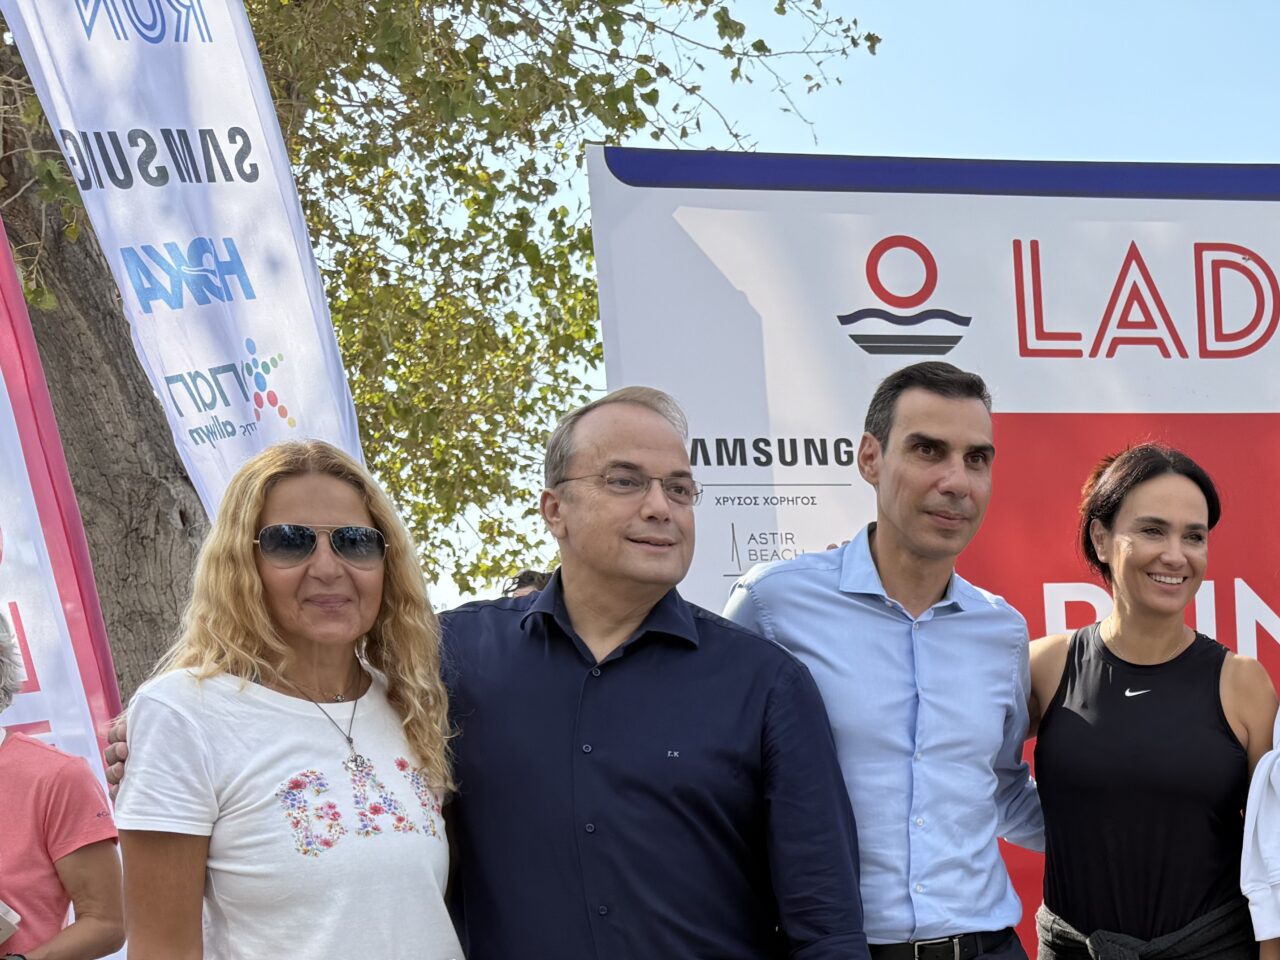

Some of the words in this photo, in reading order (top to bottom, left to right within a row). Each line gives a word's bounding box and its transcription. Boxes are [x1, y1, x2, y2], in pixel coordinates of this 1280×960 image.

[689, 437, 855, 467] AMSUNG
[715, 496, 760, 506] ΧΡΥΣΟΣ
[763, 495, 818, 506] ΧΟΡΗΓΟΣ
[747, 533, 795, 545] ASTIR
